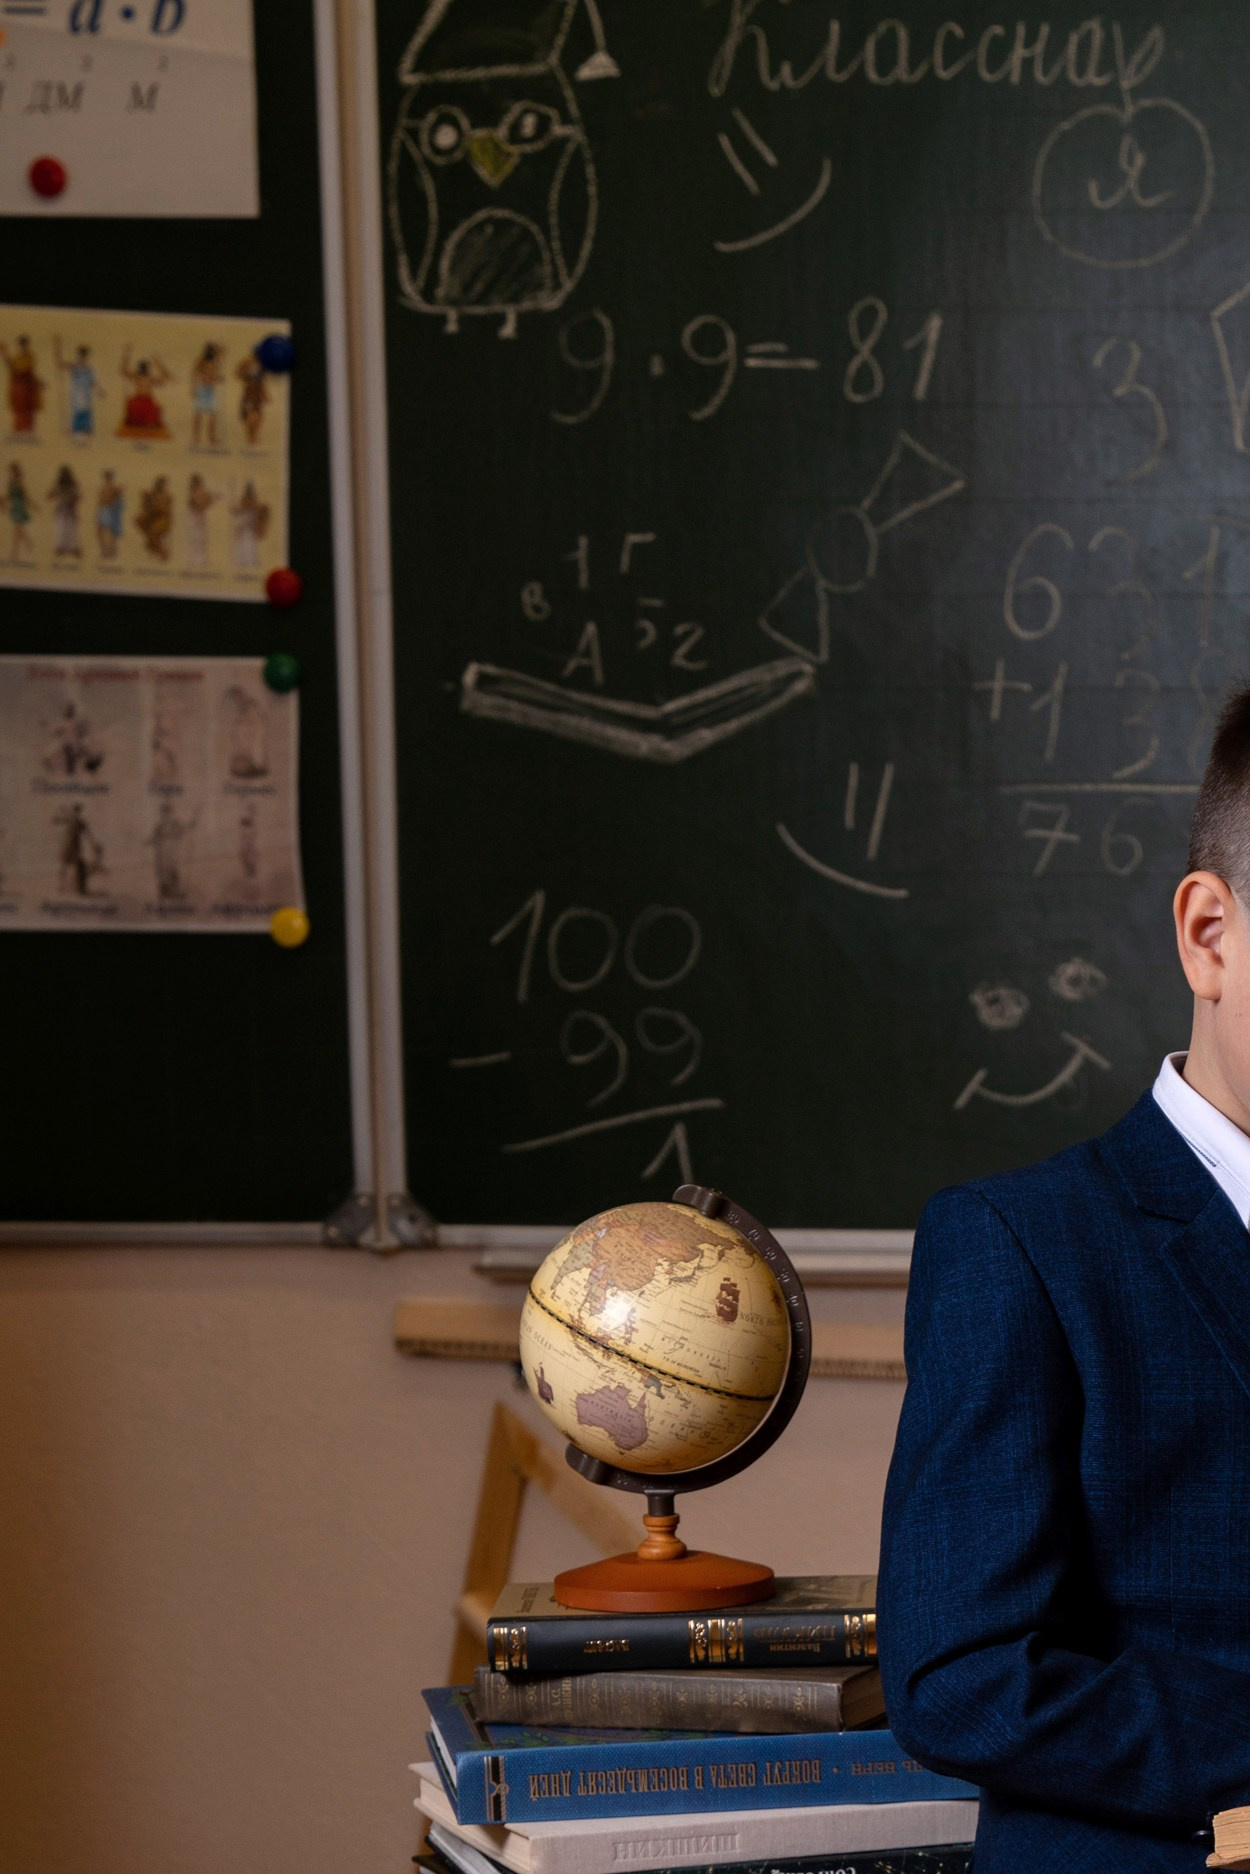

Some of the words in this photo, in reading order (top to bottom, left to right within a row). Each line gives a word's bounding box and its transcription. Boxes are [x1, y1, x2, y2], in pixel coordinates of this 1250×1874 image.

[490, 890, 701, 1002] 100
[769, 1642, 821, 1654] Валентин
[528, 1772, 572, 1801] ДНЕЙ
[577, 1766, 690, 1797] ВОСЕМЬДЕСЯТ
[694, 1765, 702, 1789] В
[711, 1762, 757, 1789] СВЕТА
[763, 1759, 823, 1786] ВОКРУГ
[611, 1832, 739, 1862] ШИШКИН
